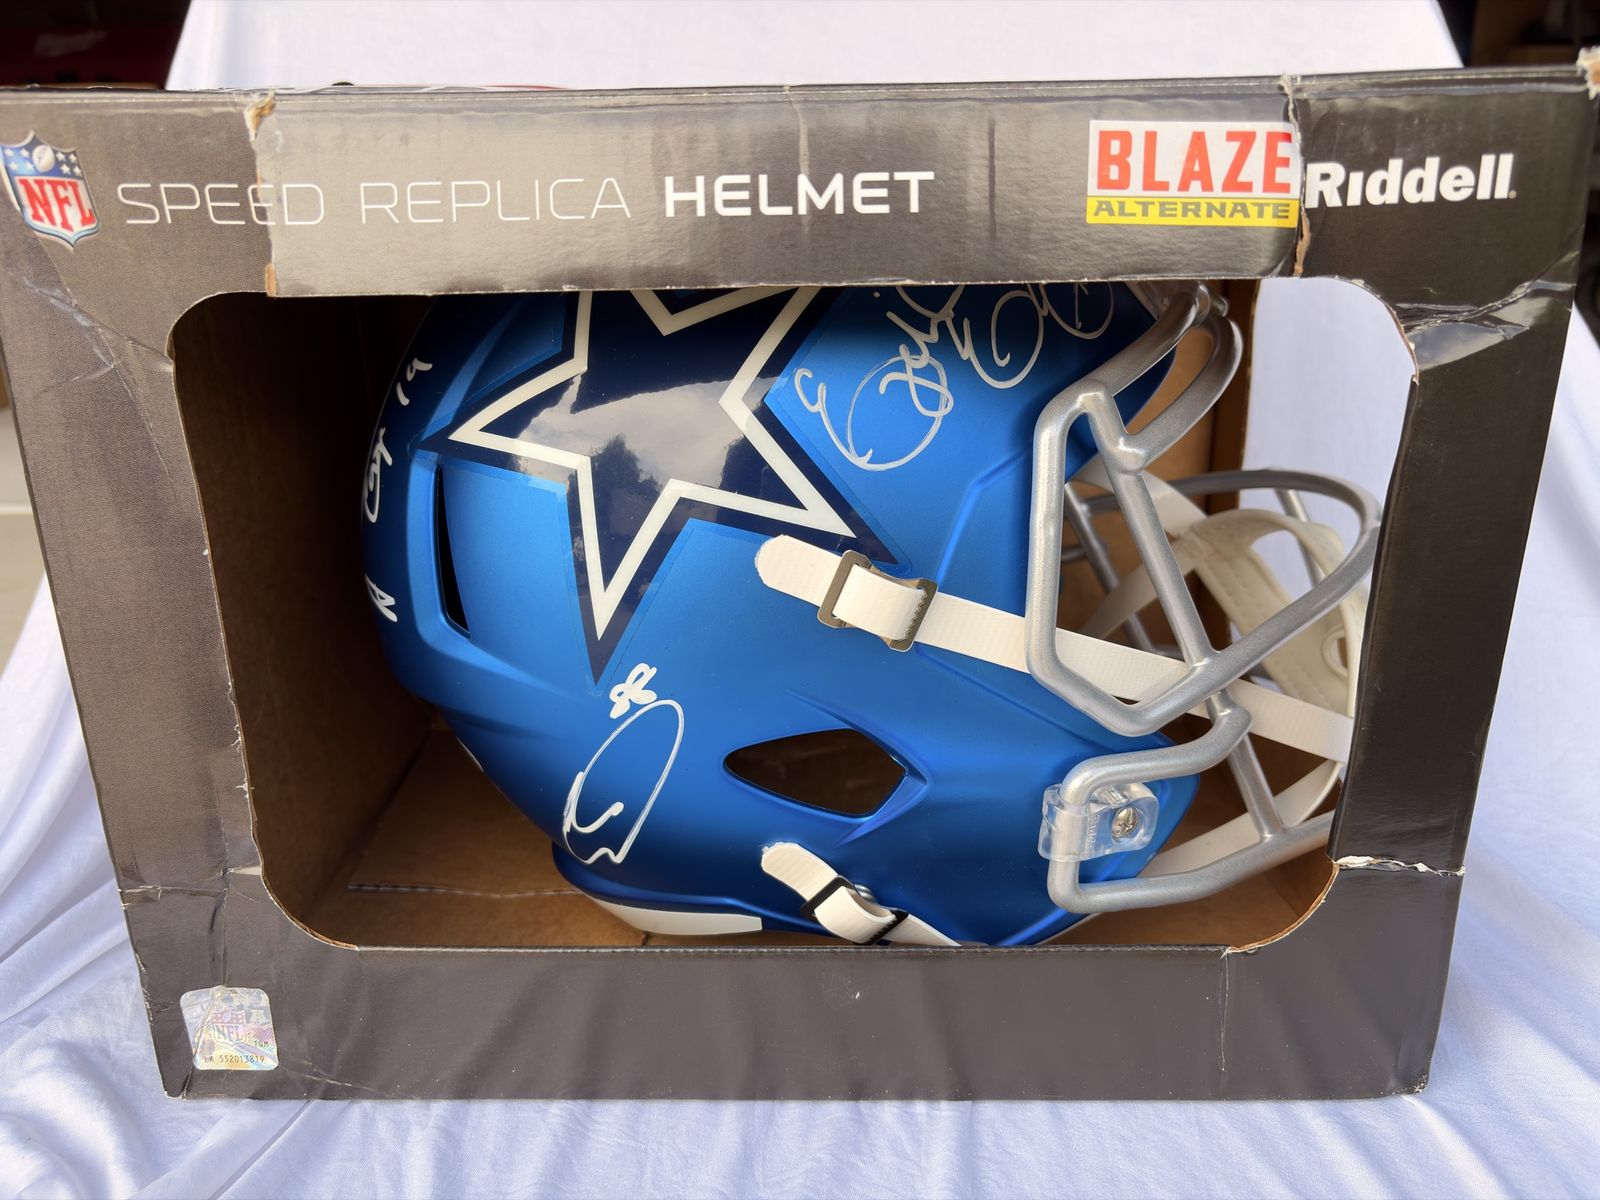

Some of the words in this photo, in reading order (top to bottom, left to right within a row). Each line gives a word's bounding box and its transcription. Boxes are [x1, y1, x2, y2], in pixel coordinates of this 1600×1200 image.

[1096, 129, 1293, 194] BLAZE
[1306, 153, 1515, 209] Riddell
[18, 177, 98, 233] NFL
[117, 182, 325, 226] SPEED
[360, 177, 632, 225] REPLICA
[664, 171, 935, 218] HELMET
[1092, 199, 1291, 221] ALTERNATE
